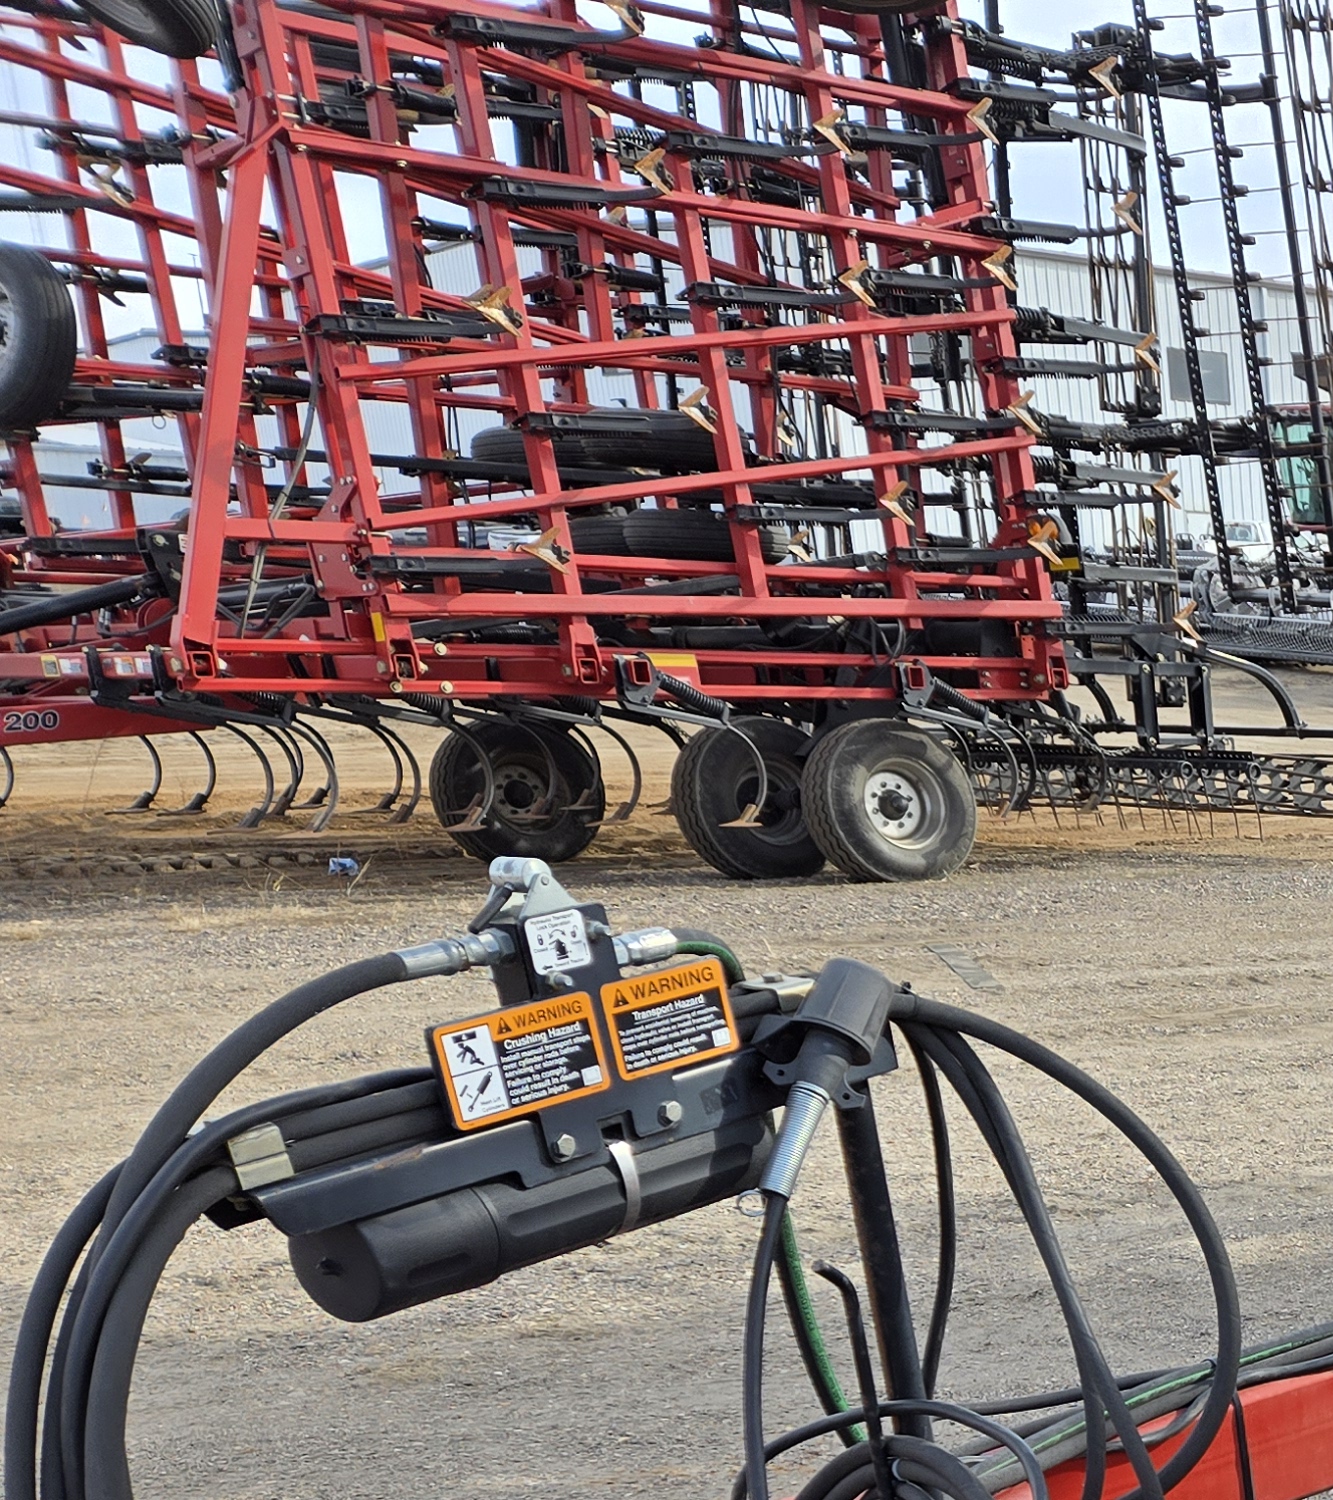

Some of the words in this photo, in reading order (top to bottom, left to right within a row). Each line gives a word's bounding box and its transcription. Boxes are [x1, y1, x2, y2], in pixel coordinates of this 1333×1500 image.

[4, 710, 59, 732] 200
[630, 967, 714, 1000] WARNING
[512, 1000, 583, 1029] WARNING
[632, 1003, 674, 1022] Transport
[673, 994, 706, 1011] Hazard
[503, 1030, 548, 1052] Crushing
[547, 1021, 582, 1040] Hazard
